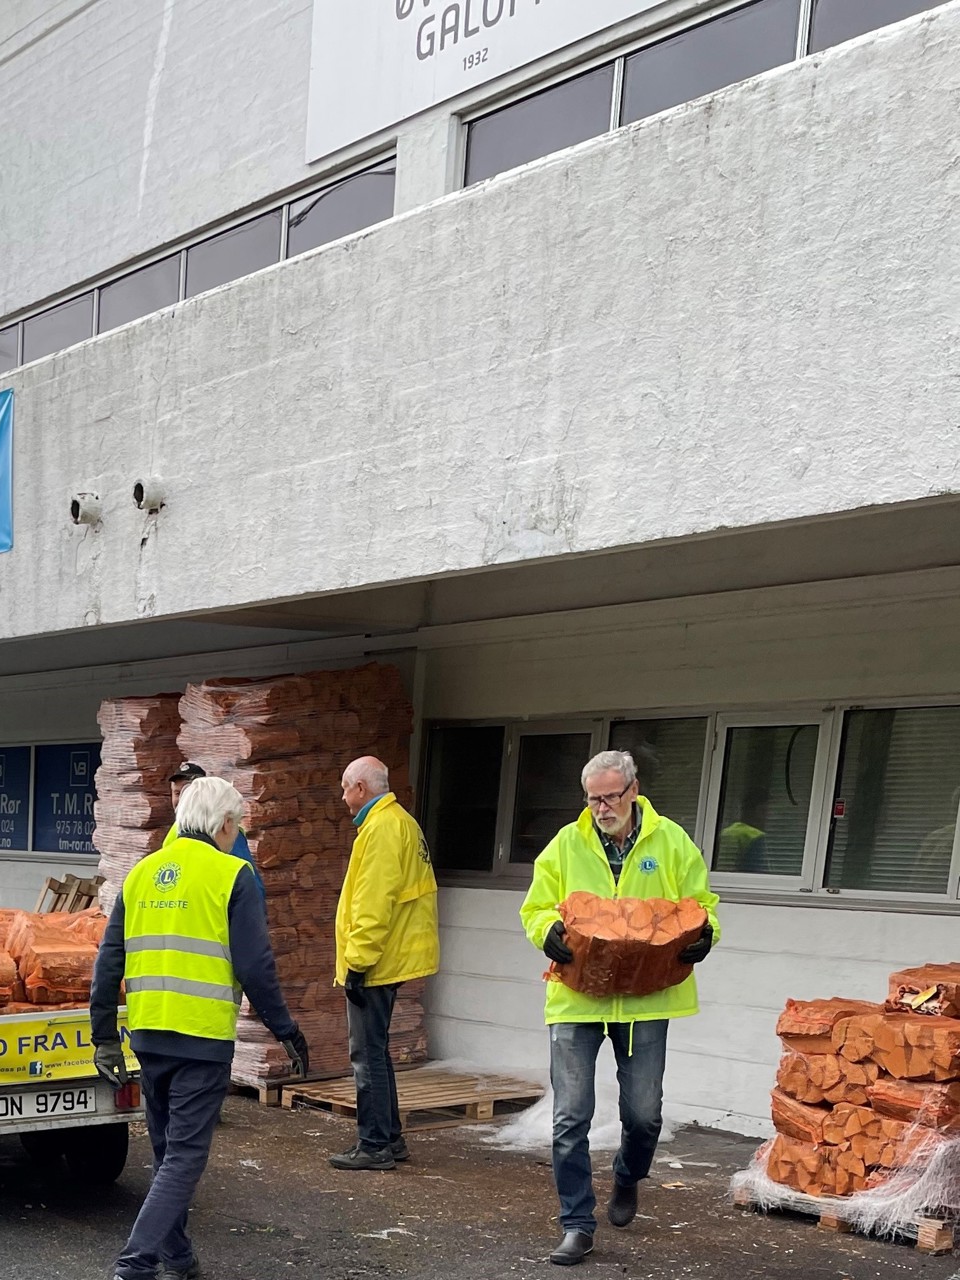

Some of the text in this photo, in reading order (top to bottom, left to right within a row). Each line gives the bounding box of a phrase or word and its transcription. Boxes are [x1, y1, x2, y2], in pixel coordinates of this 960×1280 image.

[462, 47, 489, 71] 1932
[0, 793, 21, 814] Rør
[51, 793, 61, 815] T.
[64, 793, 81, 815] M.
[1, 819, 14, 833] 024
[56, 820, 96, 835] 975 78 02
[18, 1032, 68, 1055] FRA
[16, 1066, 27, 1074] på
[35, 1089, 88, 1113] 9794
